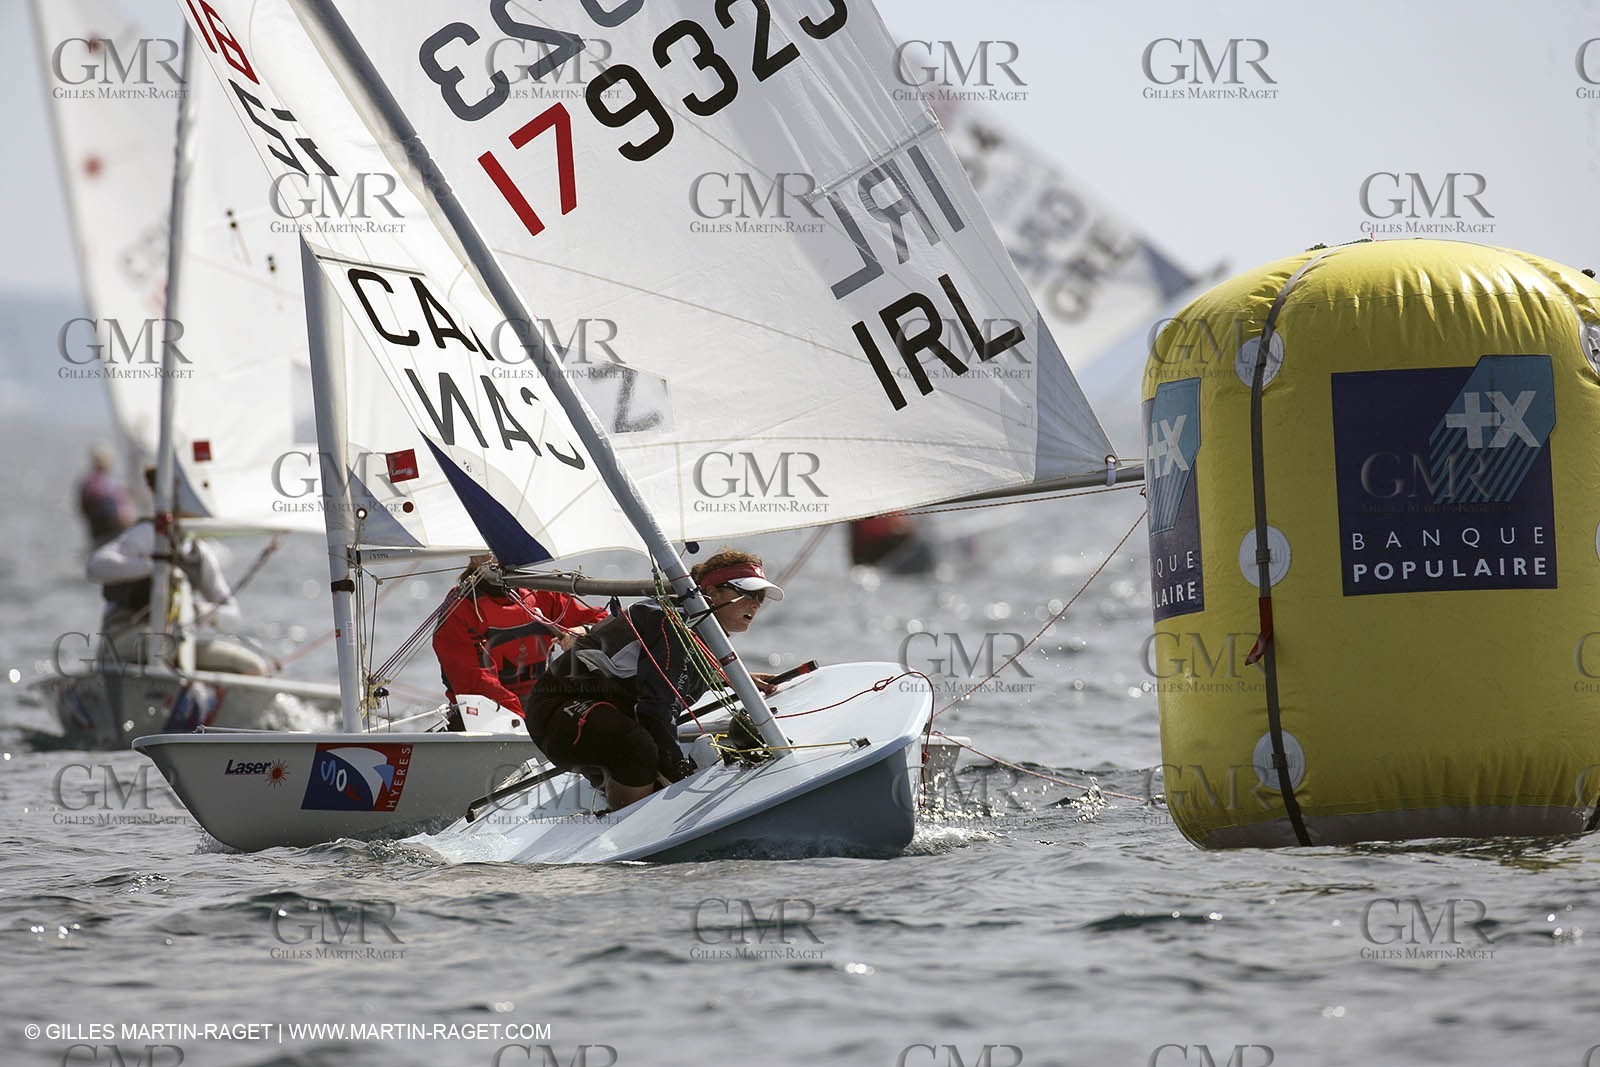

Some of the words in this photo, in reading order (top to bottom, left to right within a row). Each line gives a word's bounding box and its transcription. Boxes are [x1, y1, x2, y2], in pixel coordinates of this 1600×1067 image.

[347, 268, 495, 361] CA
[851, 273, 1026, 411] IRL
[1351, 526, 1545, 551] BANQUE
[1156, 550, 1194, 578] QUE
[1352, 557, 1547, 583] POPULAIRE
[1153, 581, 1196, 609] LAIRE
[224, 759, 272, 776] Laser
[386, 746, 412, 809] HYERES
